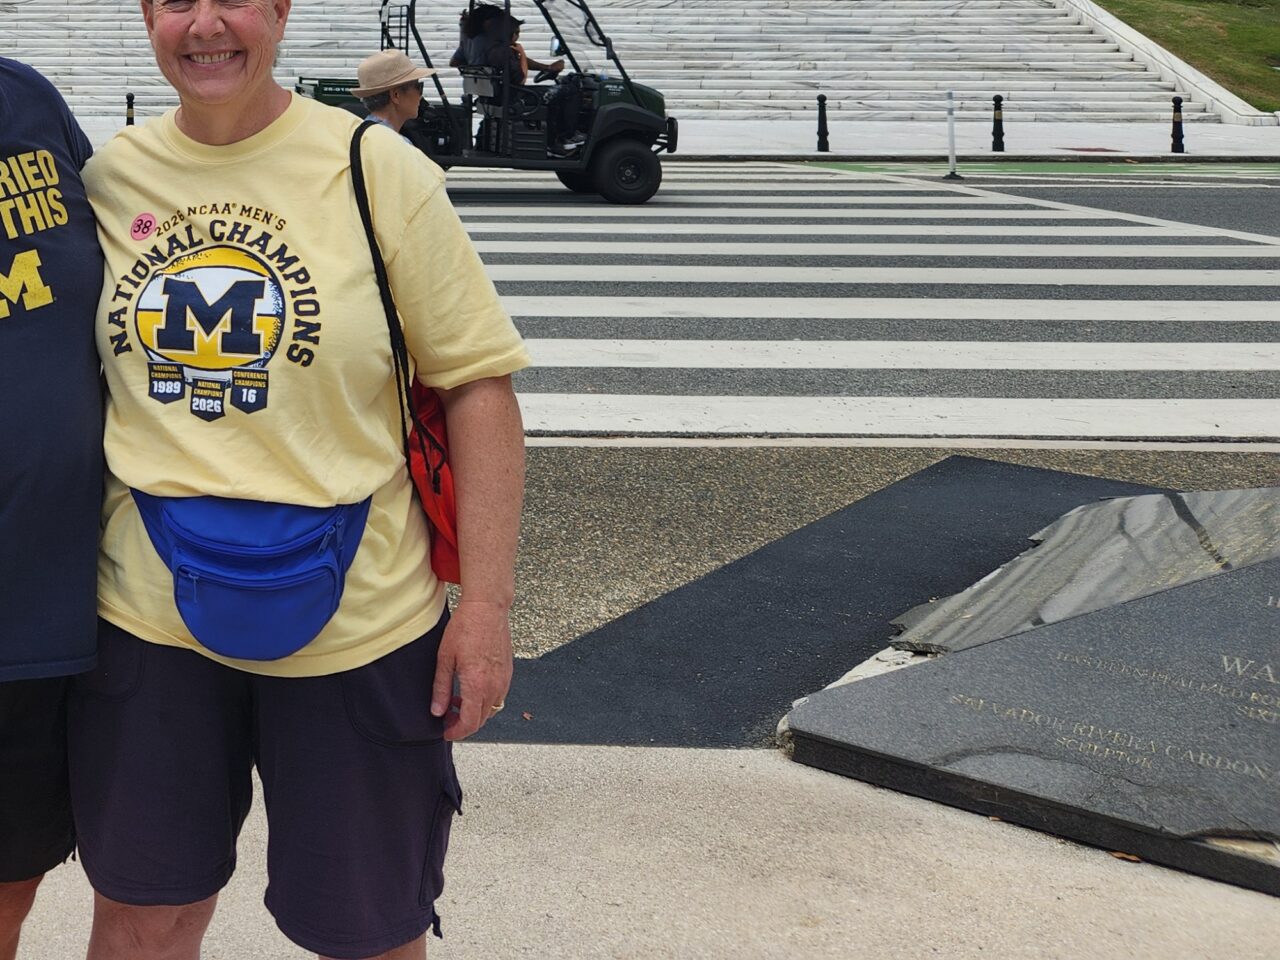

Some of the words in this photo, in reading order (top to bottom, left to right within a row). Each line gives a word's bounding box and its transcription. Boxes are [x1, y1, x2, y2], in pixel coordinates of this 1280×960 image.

[133, 218, 153, 235] 38
[155, 210, 185, 238] 2026
[239, 205, 287, 231] MEN'S
[108, 224, 204, 357] NATIONAL
[208, 219, 322, 368] CHAMPIONS
[155, 277, 267, 357] M
[152, 364, 178, 372] NATIONAL
[233, 371, 268, 380] CONFERENCE
[152, 380, 182, 394] 1989
[197, 380, 221, 390] NATIONAL
[234, 379, 266, 388] CHAMPIONS
[193, 388, 223, 398] CHAMPIONS
[241, 388, 257, 404] 16
[192, 397, 222, 413] 2026
[950, 693, 1067, 732] SALVADOR
[1073, 722, 1160, 755] RIVERA
[1056, 736, 1153, 770] SCULPTOR
